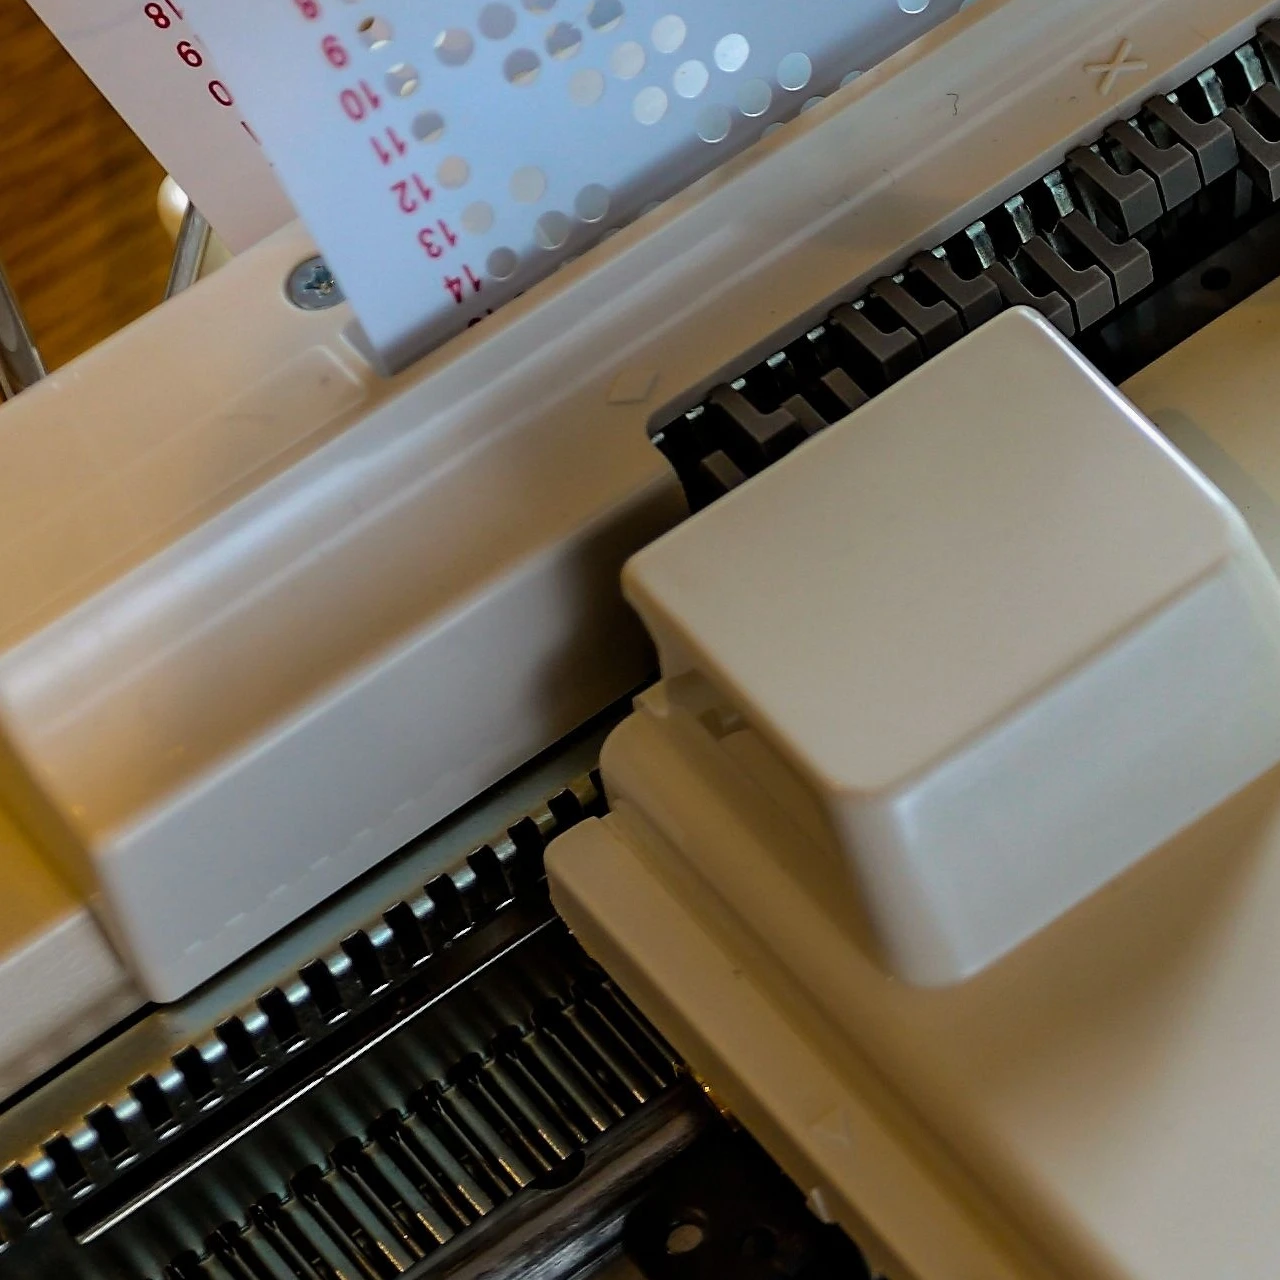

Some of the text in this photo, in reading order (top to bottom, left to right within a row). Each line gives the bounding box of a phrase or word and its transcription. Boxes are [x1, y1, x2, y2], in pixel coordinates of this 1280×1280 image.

[321, 34, 350, 69] 9
[339, 79, 381, 122] 10
[370, 126, 407, 166] 11
[389, 172, 432, 215] 12
[417, 219, 458, 259] 13
[443, 264, 482, 304] 14
